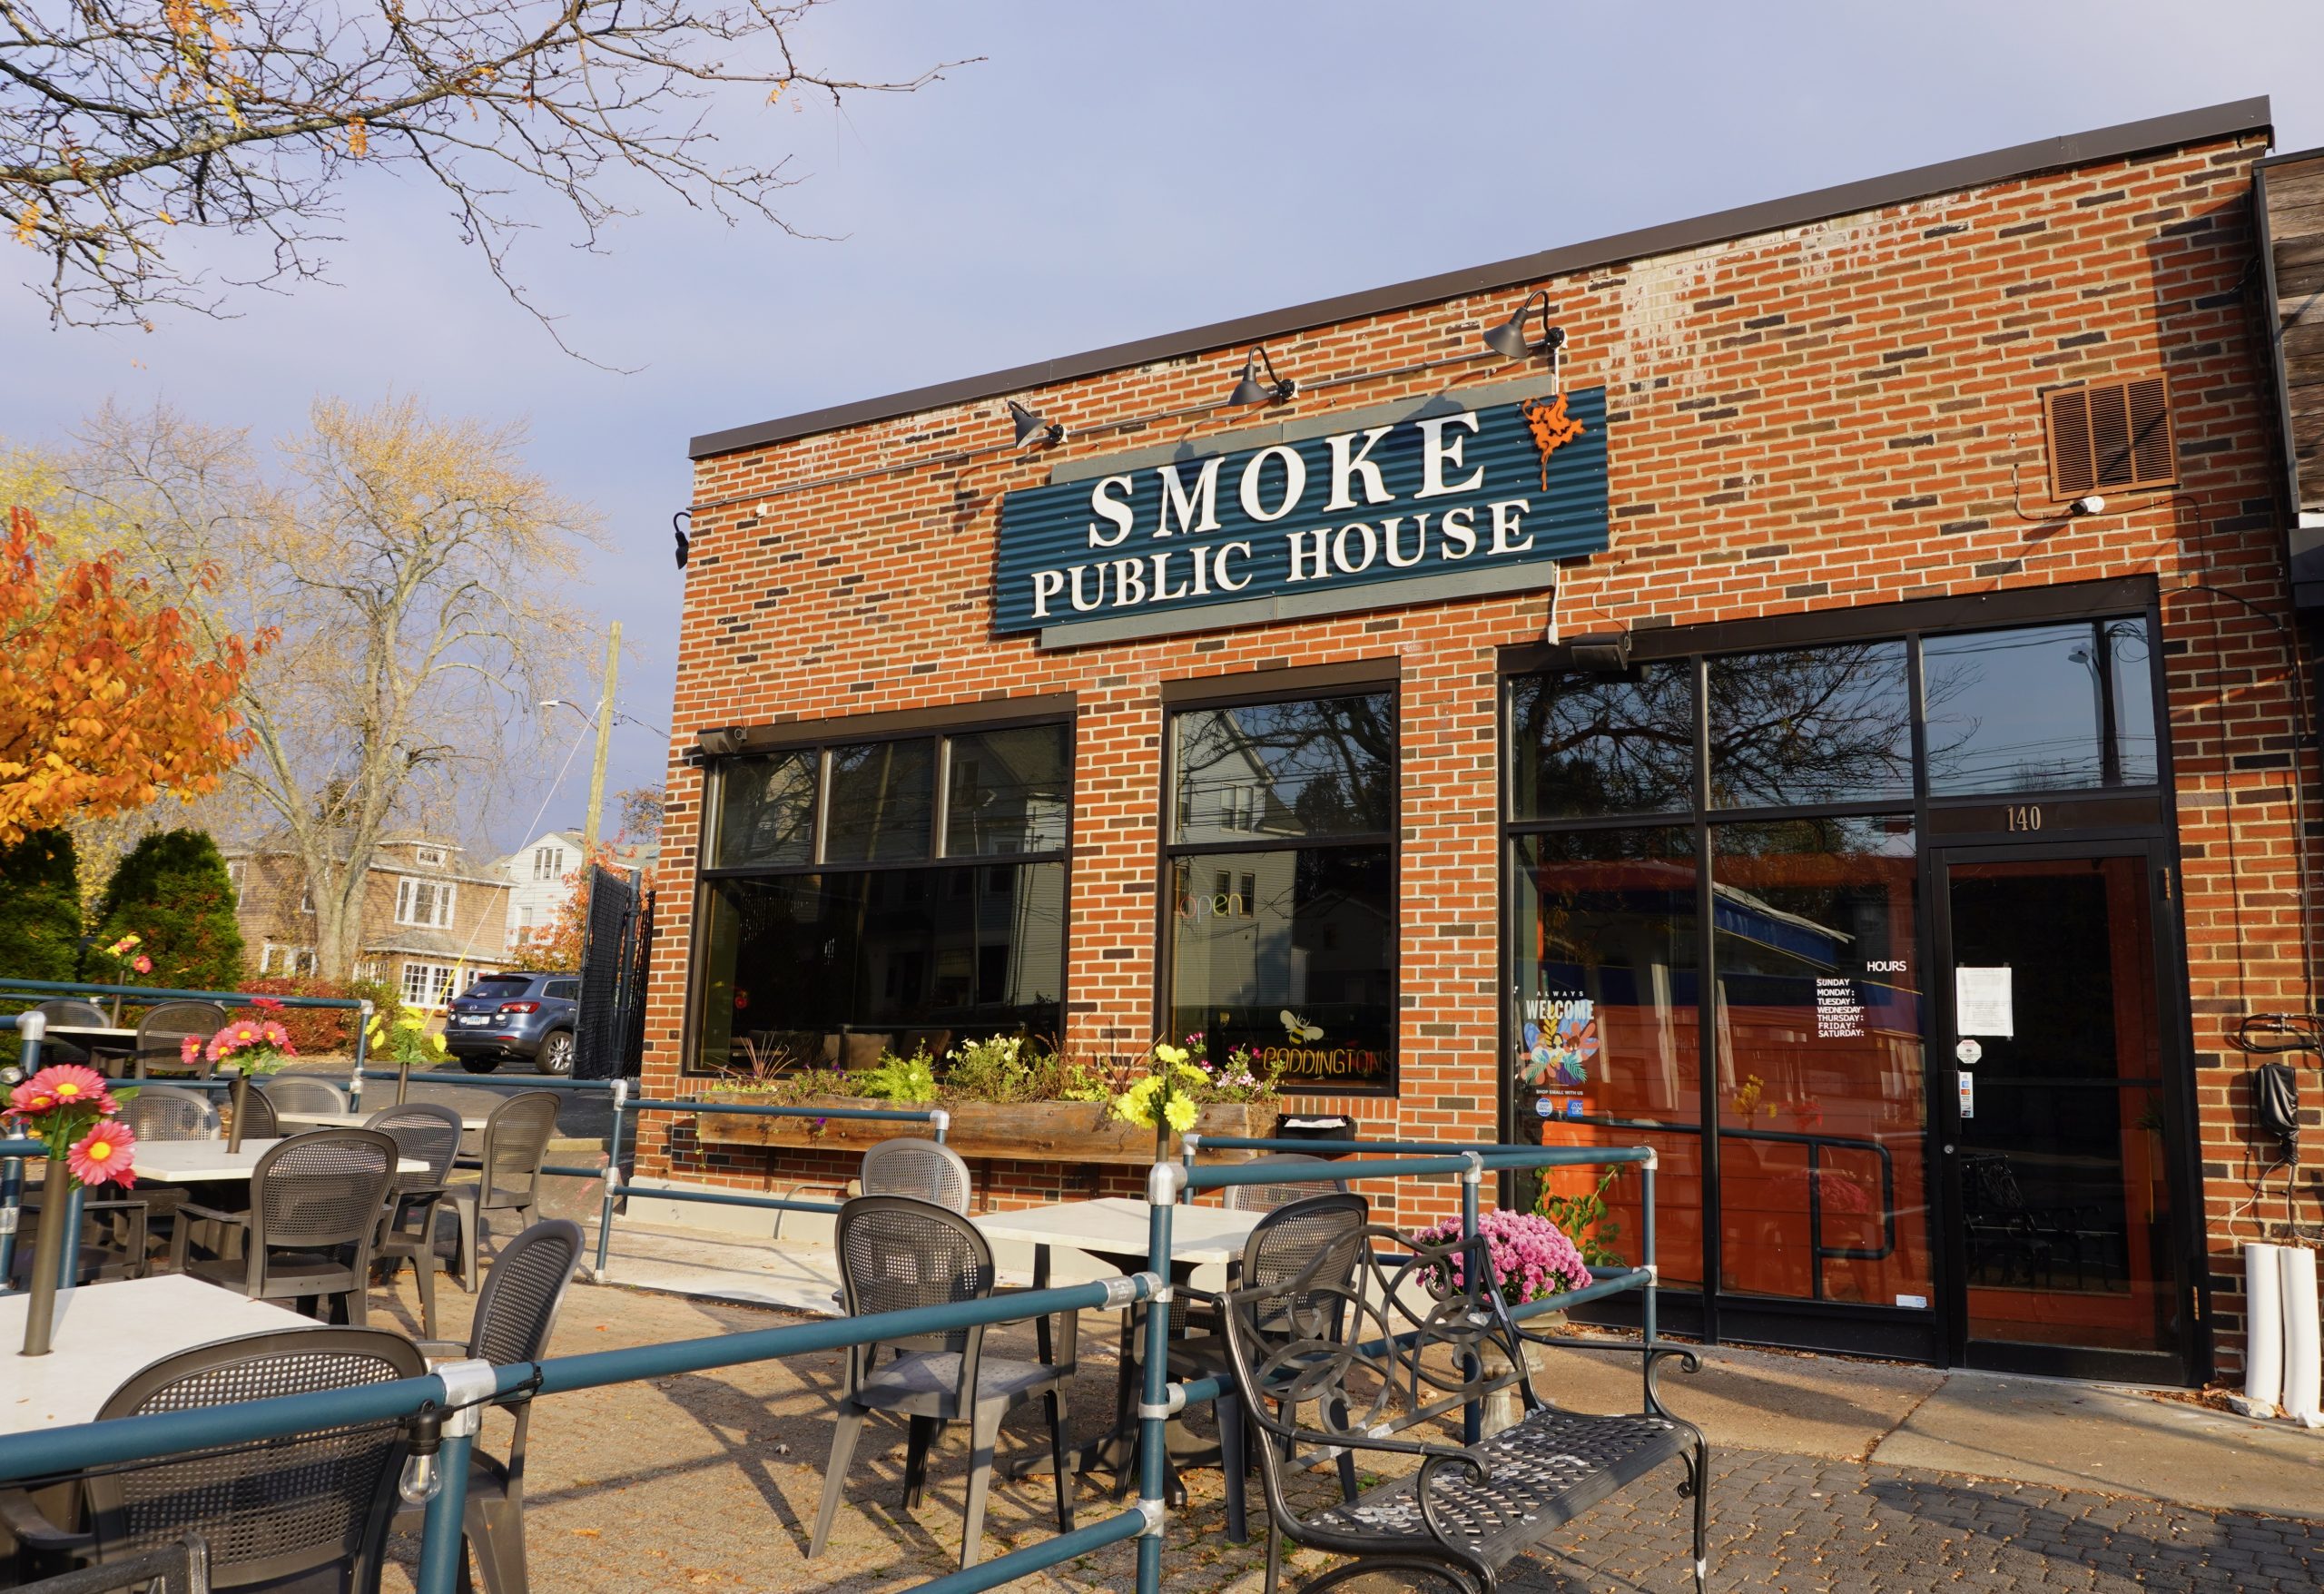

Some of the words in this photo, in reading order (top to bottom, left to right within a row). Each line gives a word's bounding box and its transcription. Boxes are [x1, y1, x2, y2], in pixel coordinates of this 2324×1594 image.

[1088, 411, 1486, 548] SMOKE
[1030, 540, 1253, 618] PUBLIC
[1285, 497, 1535, 583] HOUSE
[2007, 805, 2041, 831] 140
[1180, 893, 1243, 923] open
[1866, 960, 1906, 972] HOURS
[1817, 979, 1850, 987] SUNDAY
[1526, 999, 1595, 1020] WELCOME
[1818, 1029, 1865, 1038] SATURDAY:
